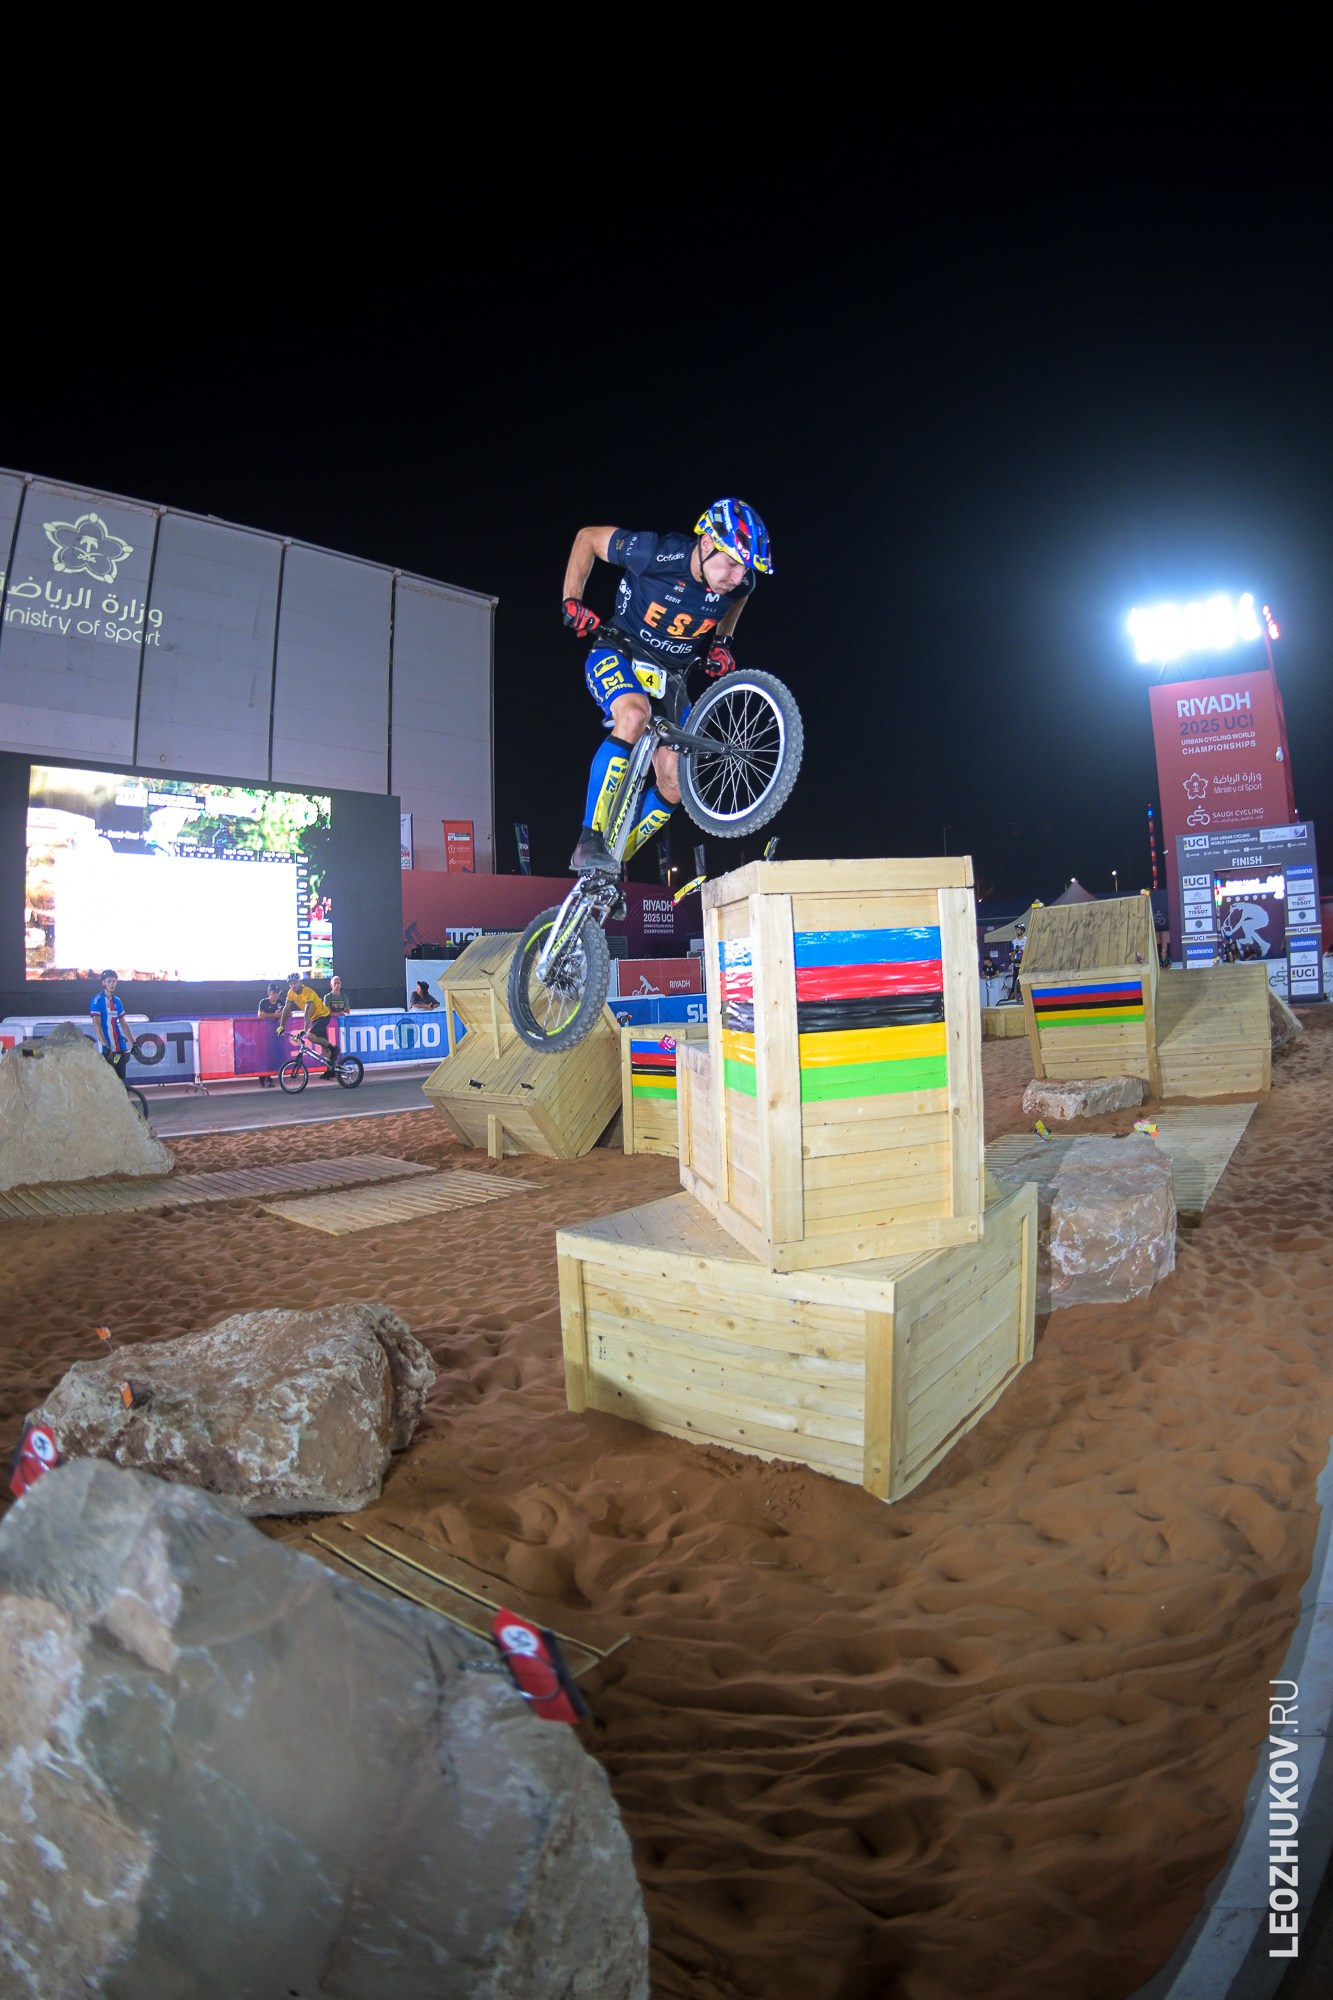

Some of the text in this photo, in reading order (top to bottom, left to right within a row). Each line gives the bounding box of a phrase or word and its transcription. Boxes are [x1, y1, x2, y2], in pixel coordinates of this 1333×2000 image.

[656, 552, 685, 562] Cofidis
[102, 593, 163, 628] وزارة
[4, 603, 161, 647] inistry of Sport
[639, 628, 693, 654] Cofidis
[645, 674, 654, 686] 4
[1177, 692, 1250, 718] RIYADH
[1180, 714, 1254, 736] 2025 UCI
[1181, 731, 1256, 746] URBAN CYCLING WORLD
[1182, 739, 1256, 755] CHAMPIONSHIPS
[1212, 811, 1233, 819] SAUDI
[1234, 807, 1264, 817] CYCLING
[1188, 837, 1207, 848] UCI
[1231, 855, 1262, 867] FINISH
[1188, 876, 1208, 886] UCI
[643, 899, 674, 911] RIYADH
[643, 913, 674, 923] 2025 UCI
[1296, 968, 1315, 978] UCI
[669, 980, 690, 988] RIYADH
